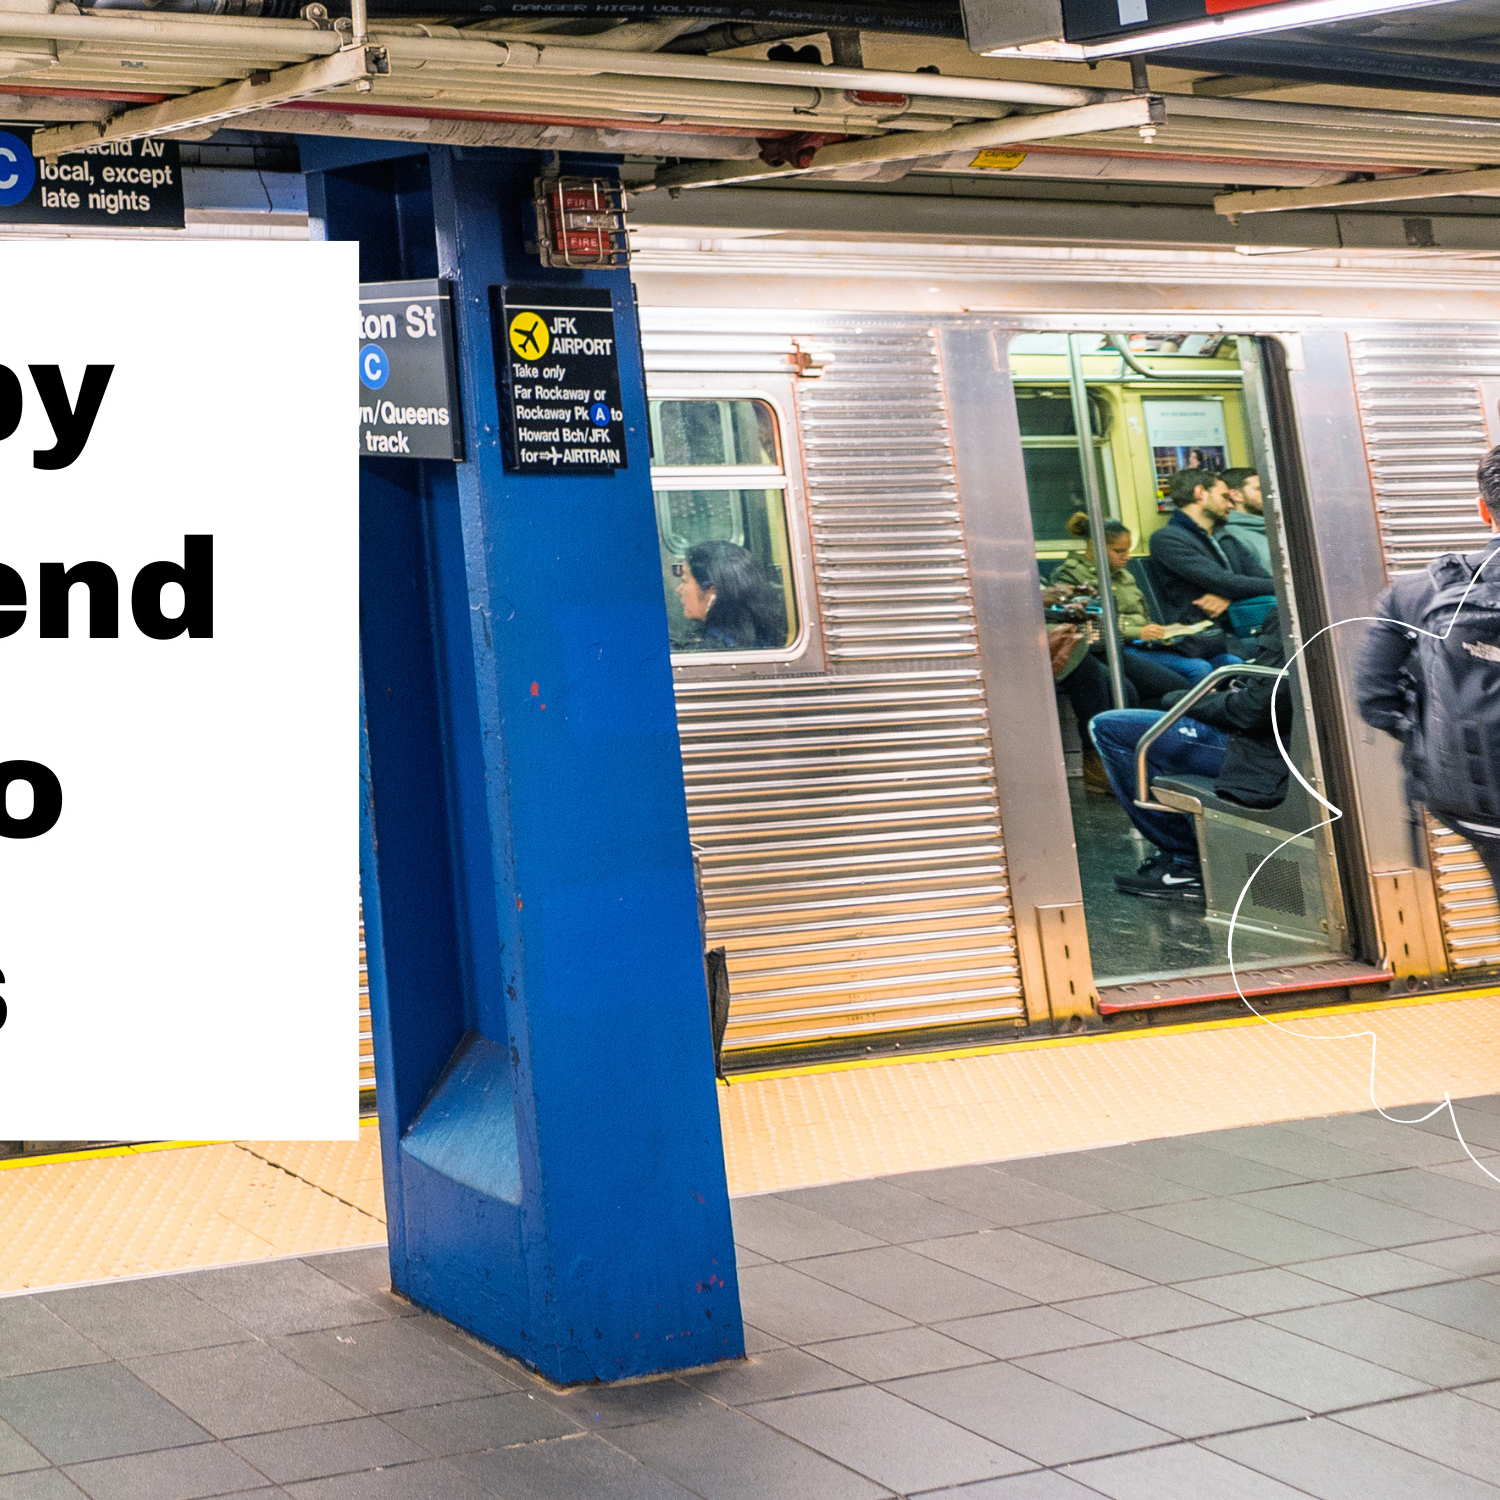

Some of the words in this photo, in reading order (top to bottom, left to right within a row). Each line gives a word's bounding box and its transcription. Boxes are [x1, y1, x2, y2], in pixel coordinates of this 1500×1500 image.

[140, 138, 165, 157] Av
[39, 159, 95, 186] local,
[102, 165, 174, 188] except
[41, 186, 81, 209] late
[88, 188, 151, 215] nights
[566, 198, 594, 207] FIRE
[570, 237, 598, 247] FIRE
[405, 304, 437, 339] St
[550, 316, 578, 335] JFK
[551, 337, 613, 356] AIRPORT
[364, 352, 382, 381] C
[512, 363, 539, 379] Take
[543, 364, 566, 381] only
[514, 384, 533, 400] Far
[535, 385, 590, 403] Rockaway
[593, 389, 607, 401] or
[516, 405, 571, 423] Rockaway
[574, 405, 589, 421] Pk
[595, 407, 606, 421] A
[610, 408, 623, 422] to
[365, 430, 411, 454] track
[518, 427, 560, 443] Howard
[562, 428, 611, 444] Bch/JFK
[520, 448, 539, 463] for
[562, 448, 621, 464] AIRTRAIN
